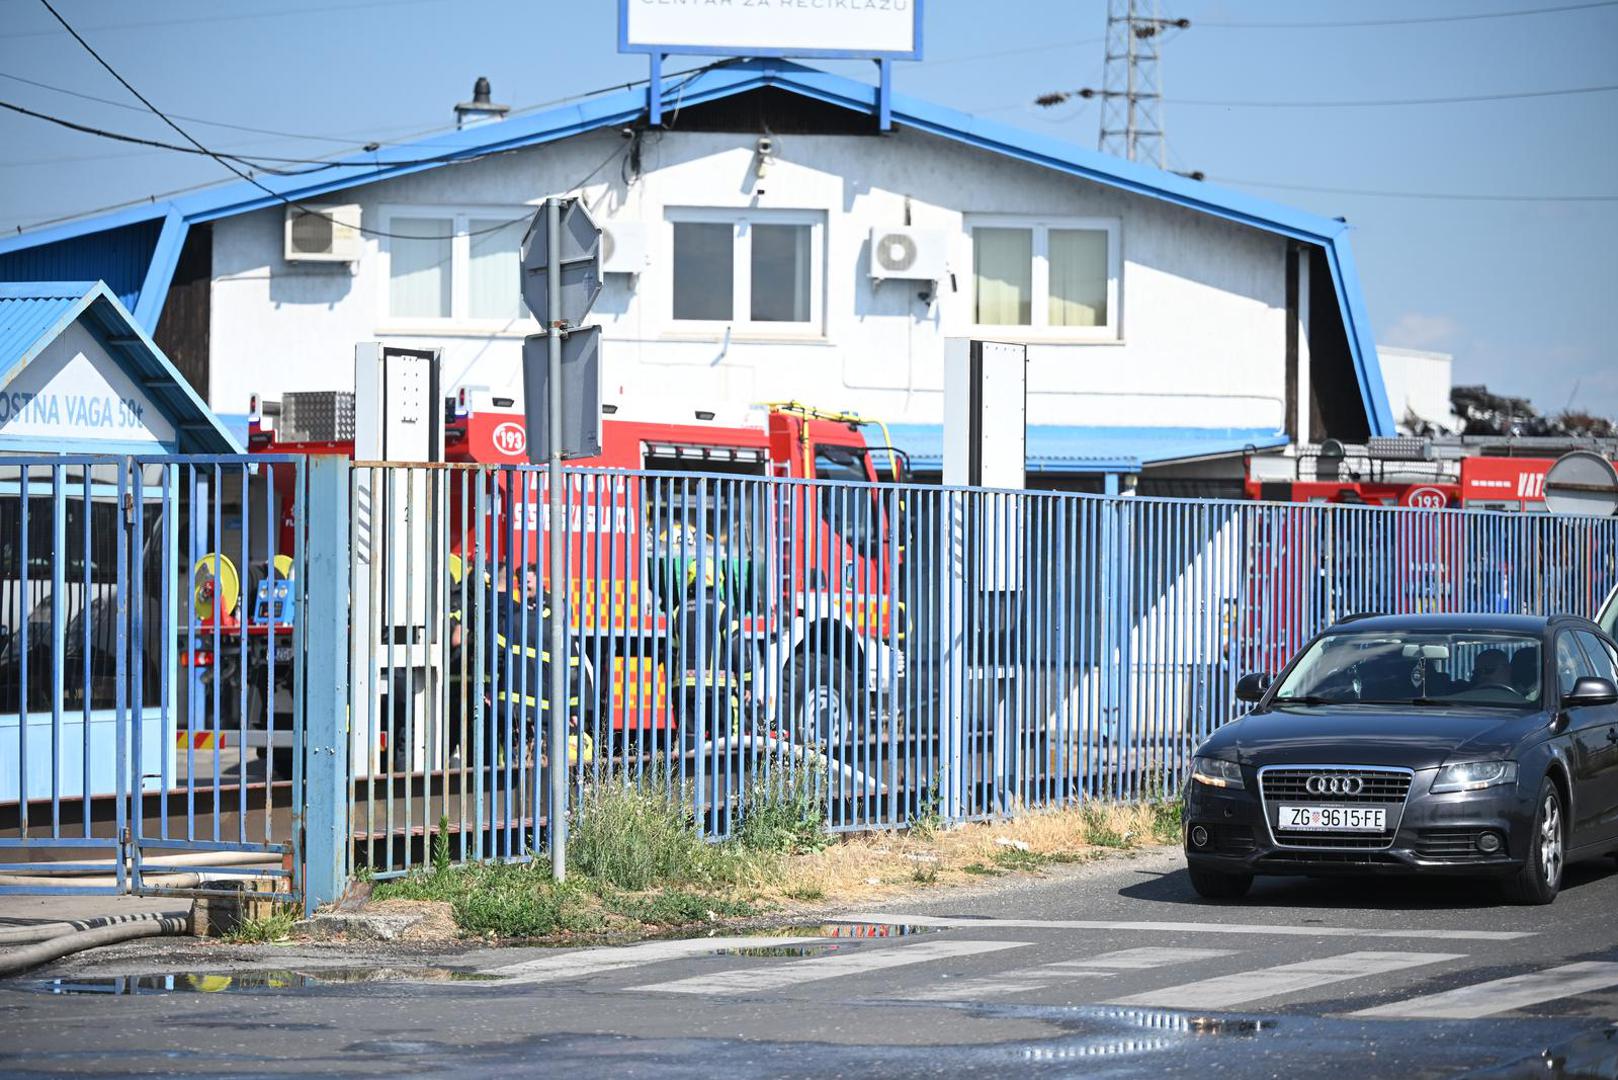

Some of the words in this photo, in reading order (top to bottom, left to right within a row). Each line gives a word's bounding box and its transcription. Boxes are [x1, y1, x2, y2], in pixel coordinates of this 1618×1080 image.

[65, 394, 114, 428] VAGA
[118, 398, 143, 428] 50t
[500, 430, 523, 450] 193
[1517, 472, 1545, 497] VAT
[1417, 495, 1440, 508] 193
[1291, 808, 1310, 826] ZG
